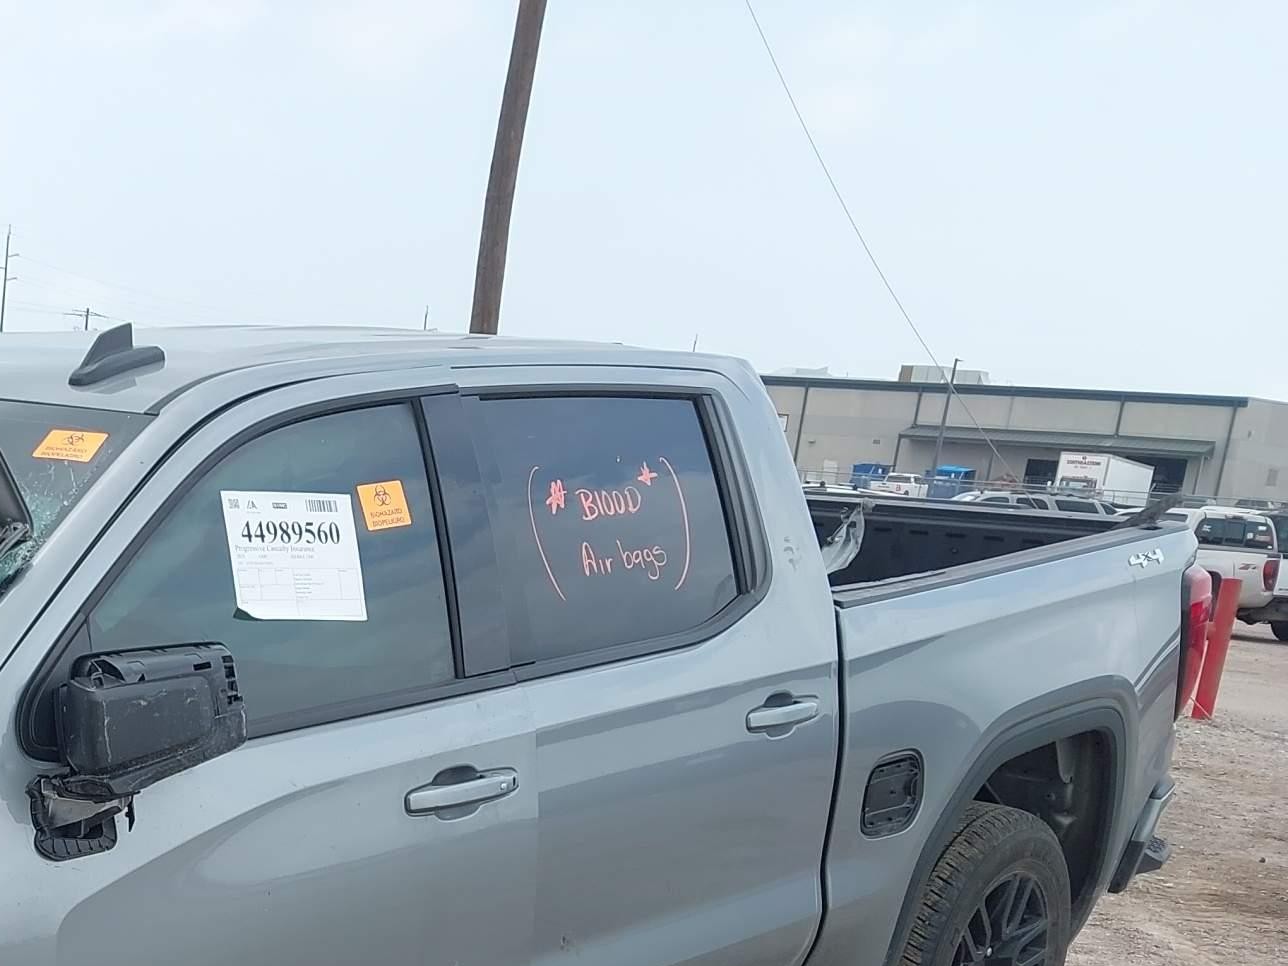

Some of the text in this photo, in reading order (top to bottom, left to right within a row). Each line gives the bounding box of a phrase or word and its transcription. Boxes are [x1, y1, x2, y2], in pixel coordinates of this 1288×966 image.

[241, 520, 341, 545] 44989560
[582, 539, 668, 580] Air bags
